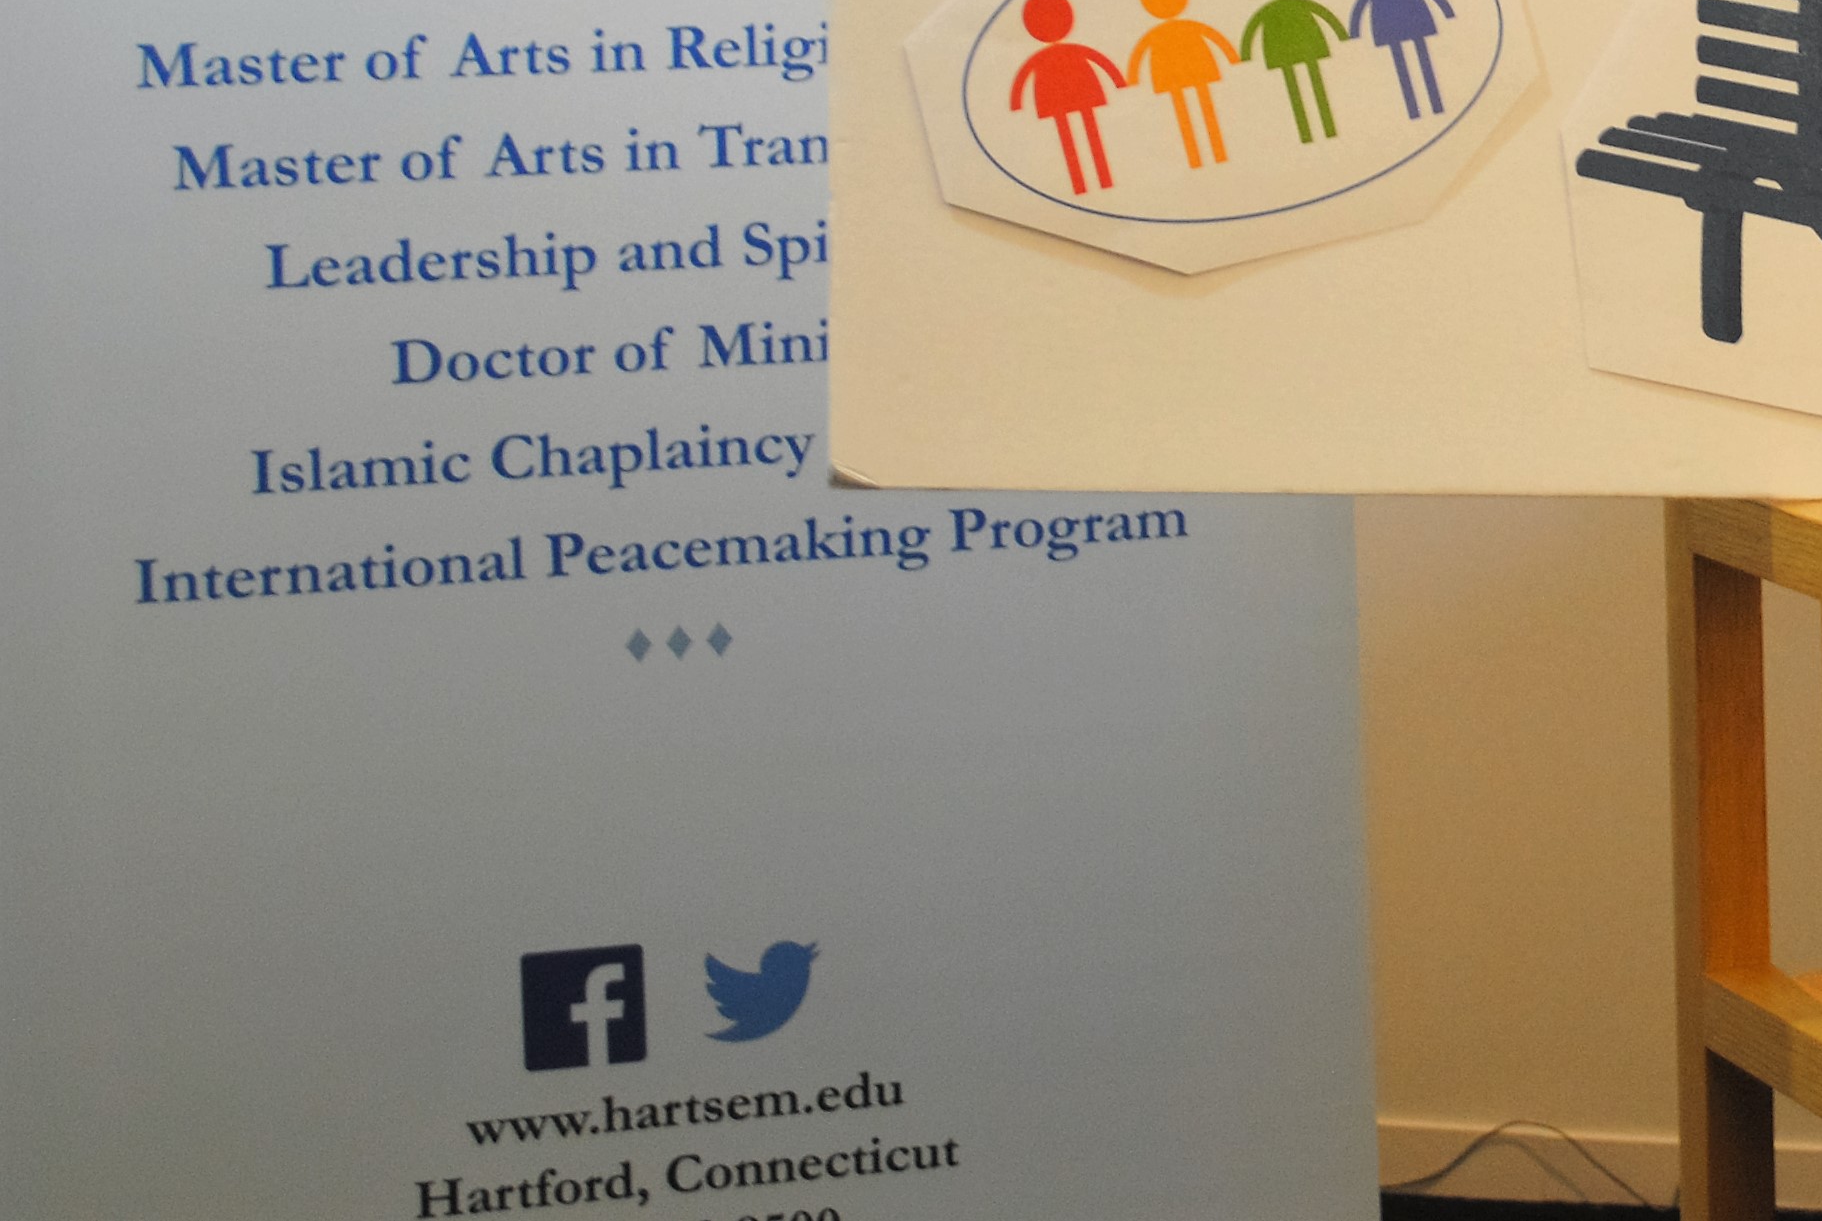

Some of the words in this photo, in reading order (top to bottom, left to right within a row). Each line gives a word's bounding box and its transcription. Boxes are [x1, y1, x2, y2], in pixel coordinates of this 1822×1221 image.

[135, 40, 345, 90] Master
[364, 36, 427, 81] of
[449, 32, 570, 78] Arts
[591, 29, 645, 73] in
[172, 143, 382, 191] Master
[401, 135, 462, 182] of
[484, 133, 605, 178] Arts
[625, 128, 681, 173] in
[697, 122, 828, 169] Tran
[265, 233, 598, 291] Leadership
[619, 223, 723, 271] and
[743, 220, 828, 281] Spi
[391, 336, 597, 386] Doctor
[613, 326, 675, 375] of
[698, 318, 828, 368] Mini
[250, 440, 471, 495] Islamic
[489, 423, 816, 491] Chaplaincy
[134, 537, 526, 605] International
[545, 518, 931, 580] Peacemaking
[948, 501, 1191, 564] Program
[465, 1071, 906, 1147] www.hartsem.edu
[415, 1161, 651, 1219] Hartford,
[665, 1136, 960, 1193] Connecticut
